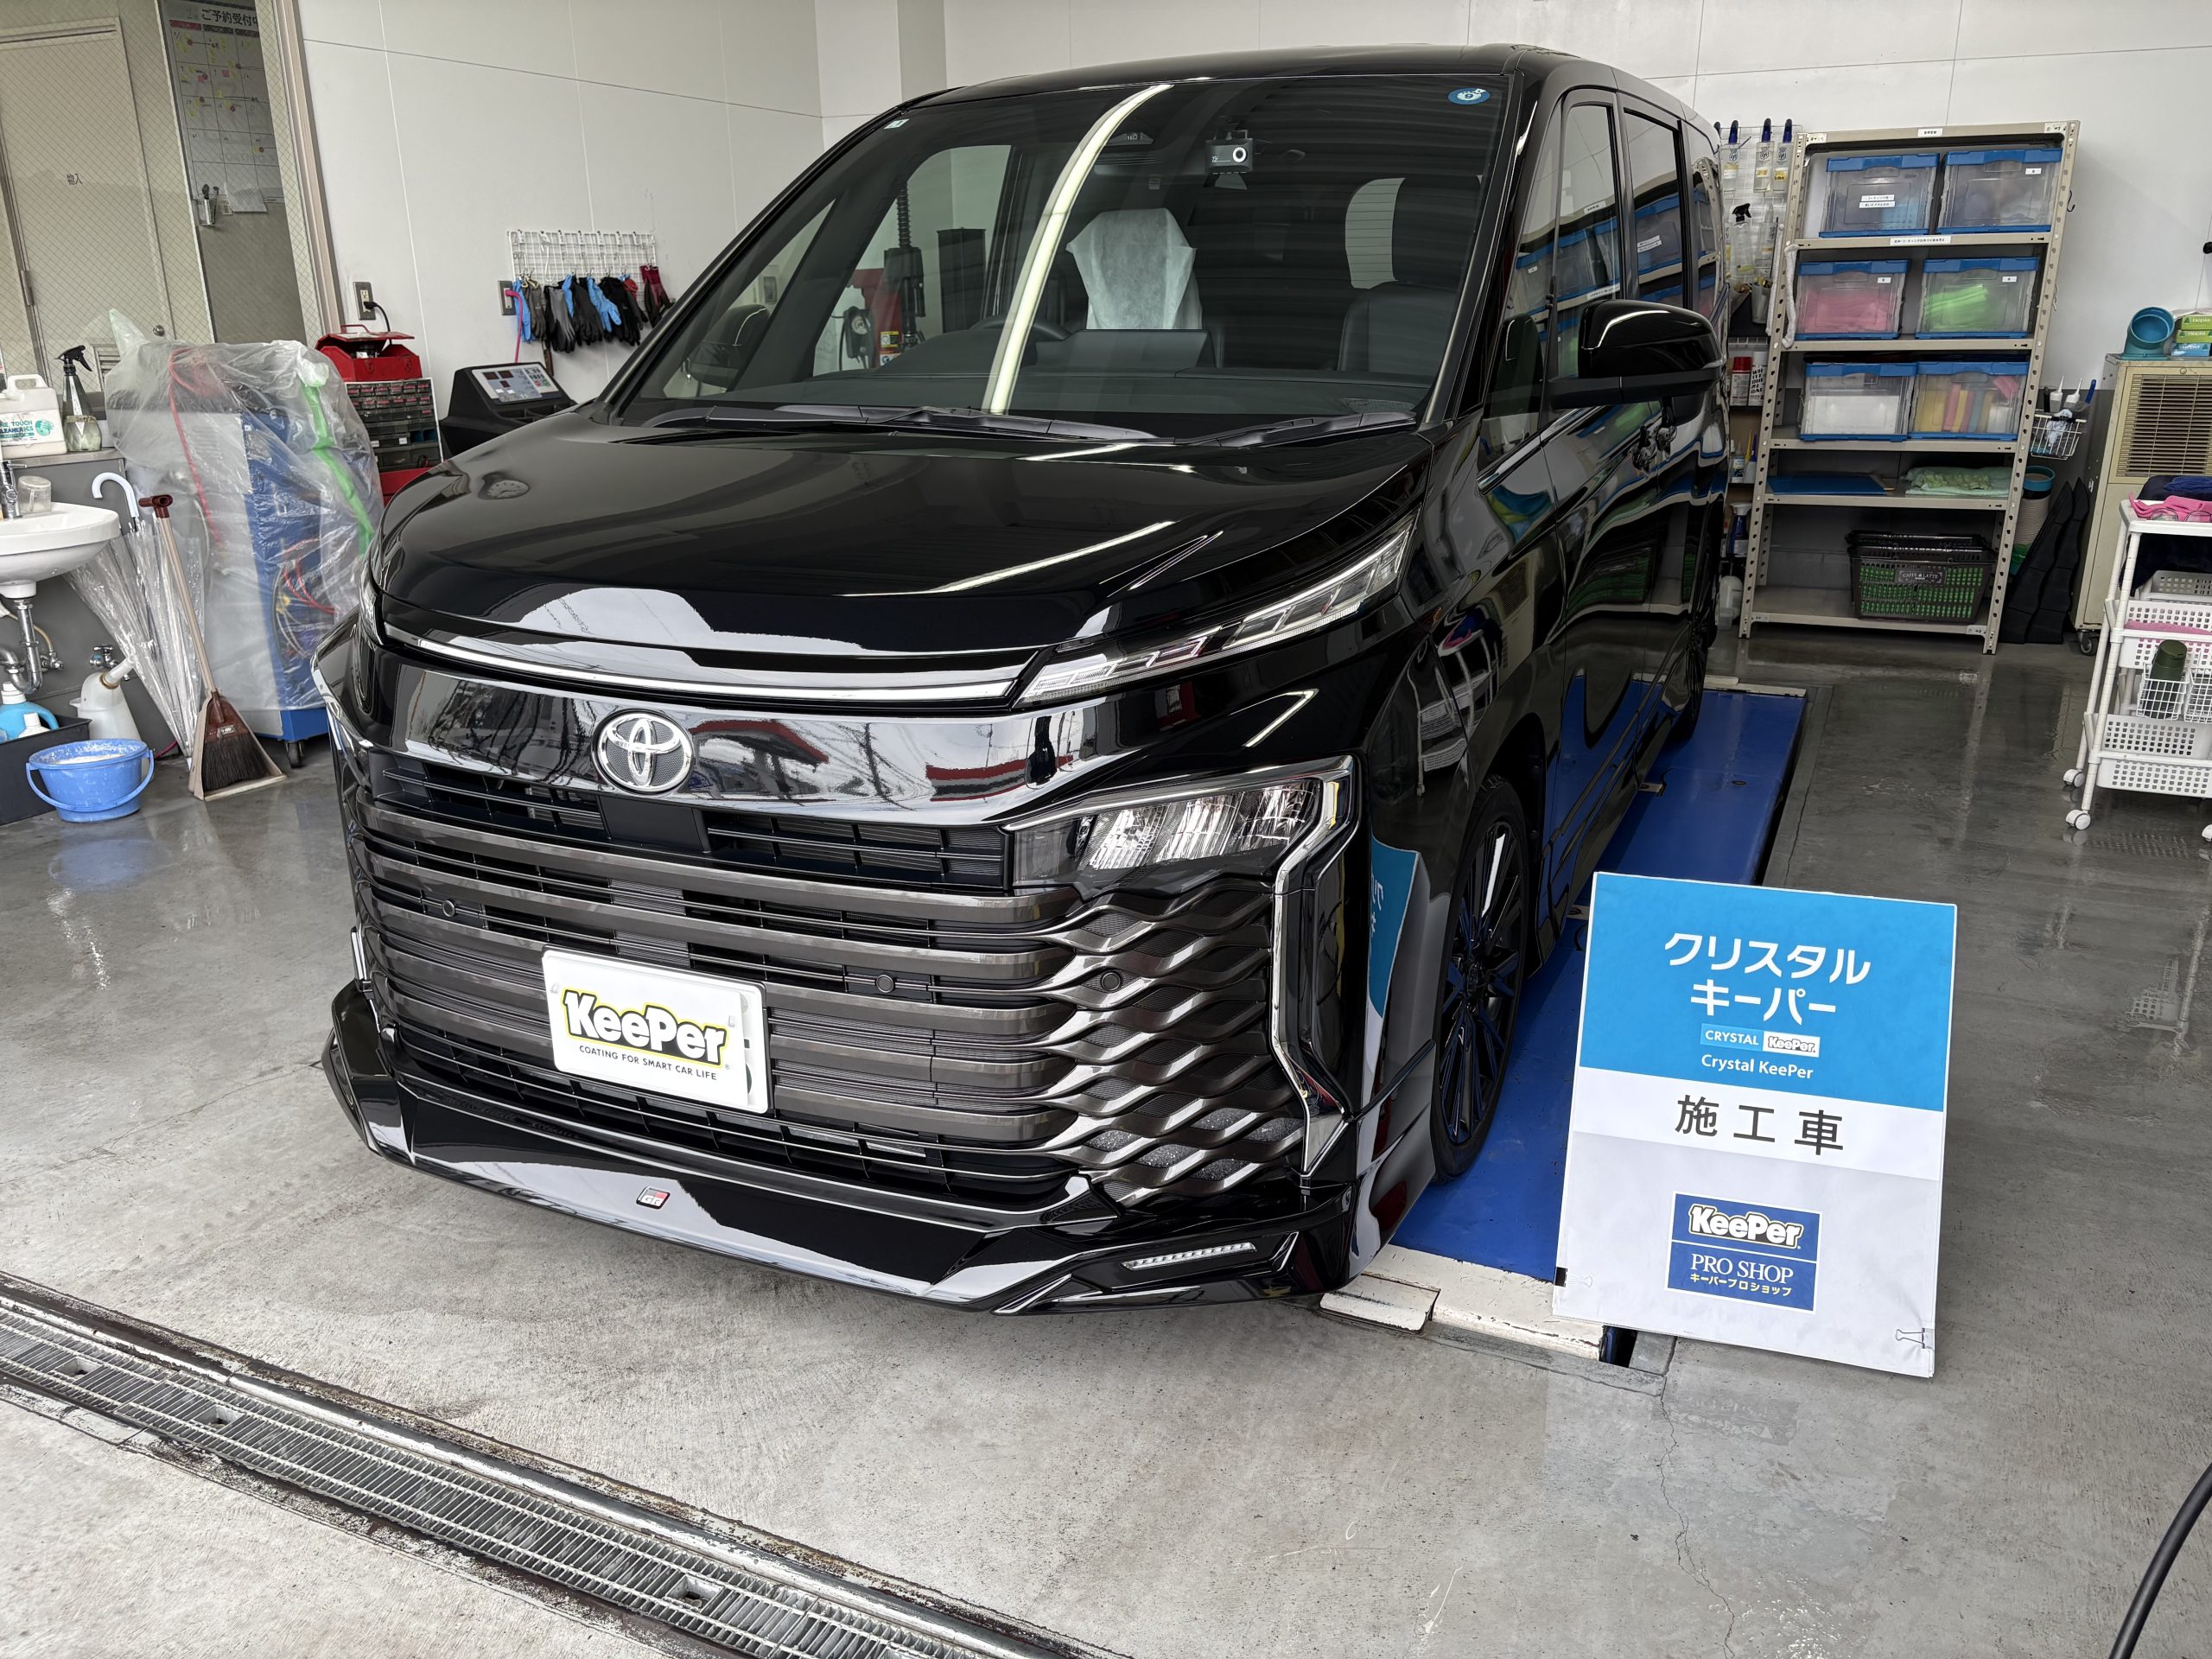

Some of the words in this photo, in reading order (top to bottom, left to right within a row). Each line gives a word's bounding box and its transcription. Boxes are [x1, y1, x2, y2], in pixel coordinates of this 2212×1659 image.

[1664, 932, 1871, 984] クリスタル
[1690, 979, 1836, 1026] キーパー
[563, 989, 728, 1065] KeePer
[1705, 1030, 1759, 1046] CRYSTAL
[1768, 1036, 1815, 1052] KeePer
[579, 1045, 619, 1060] COATING
[621, 1053, 639, 1065] FOR
[642, 1058, 672, 1071] SMART
[675, 1065, 693, 1076] CAR
[696, 1069, 717, 1080] LIFE
[1701, 1054, 1755, 1071] Crystal
[1758, 1061, 1814, 1079] KeePer
[1675, 1094, 1843, 1155] 施工車
[1689, 1205, 1802, 1248] KeePer
[1690, 1253, 1733, 1275] PRO
[1737, 1261, 1794, 1284] SHOP
[1690, 1273, 1792, 1296] キーパープロショップ
